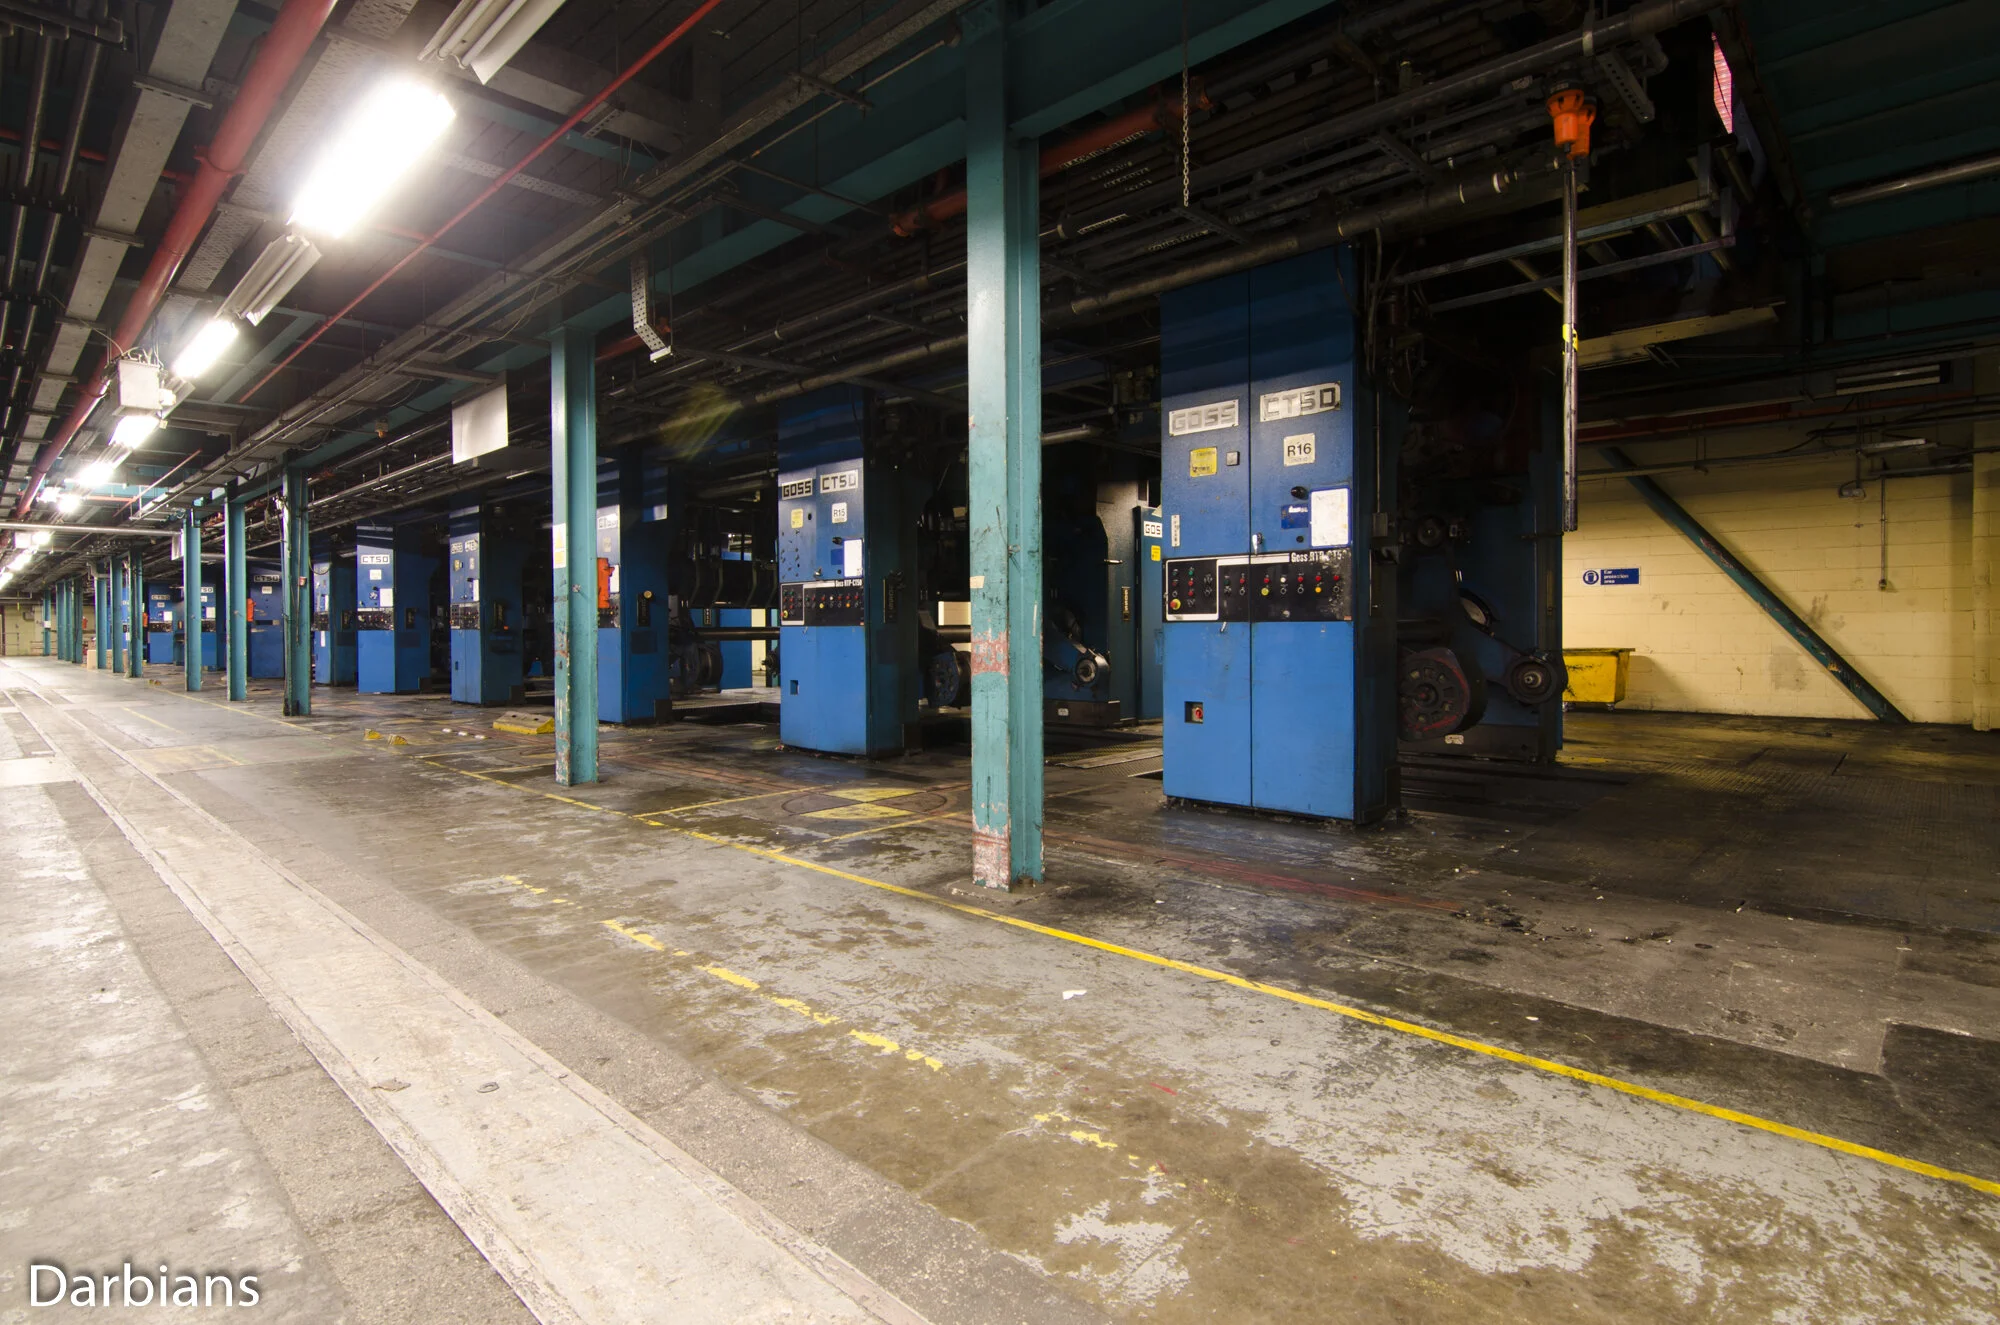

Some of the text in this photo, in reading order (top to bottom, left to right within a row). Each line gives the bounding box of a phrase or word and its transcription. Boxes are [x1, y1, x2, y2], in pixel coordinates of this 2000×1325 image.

[1172, 405, 1236, 431] GOSS
[1287, 443, 1312, 457] R16
[783, 480, 812, 497] GOSS
[1145, 523, 1161, 535] GOS
[1291, 552, 1308, 563] Goss
